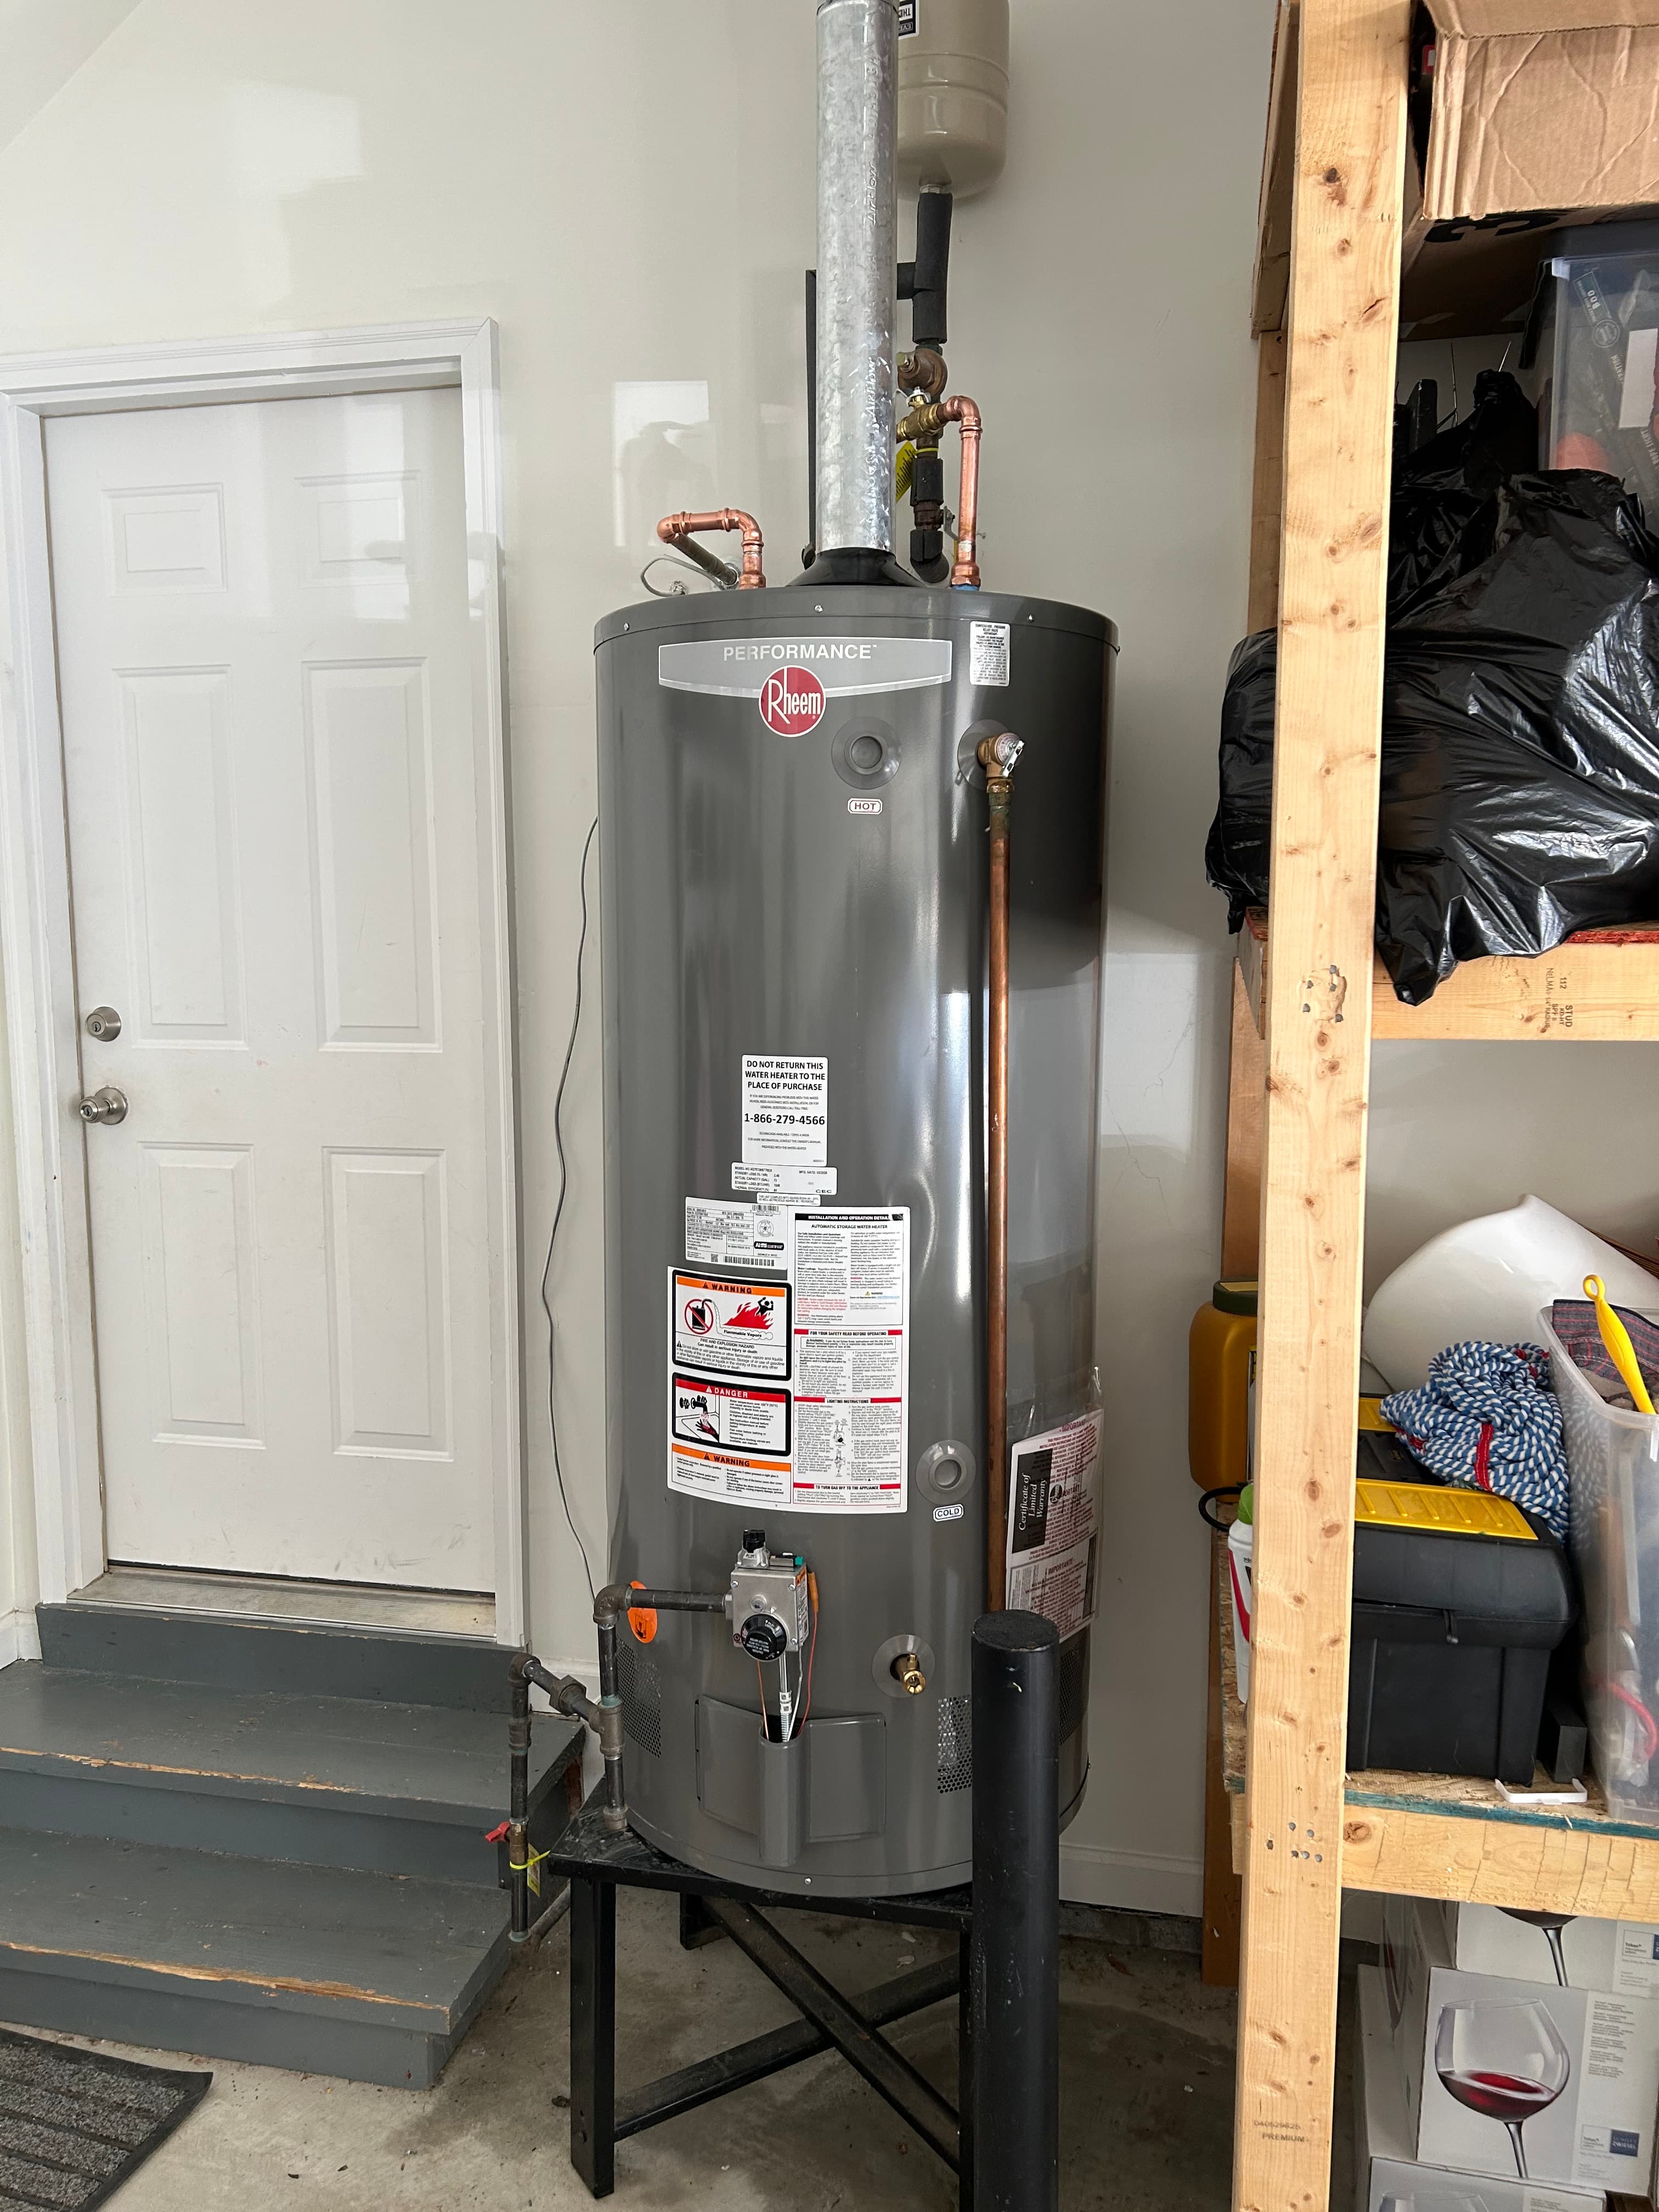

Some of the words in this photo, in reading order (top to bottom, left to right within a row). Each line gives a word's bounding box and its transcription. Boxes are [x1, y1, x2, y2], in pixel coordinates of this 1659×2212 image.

[723, 644, 871, 661] PERFORMANCE
[768, 668, 821, 724] Rheem
[744, 1113, 825, 1125] 1-866-279-4566
[712, 1283, 752, 1294] WARNING
[714, 1387, 748, 1398] DANGER
[1062, 1419, 1086, 1432] IMPORTANT
[714, 1455, 750, 1466] WARNING
[1023, 1473, 1031, 1483] of
[1029, 1484, 1037, 1517] Limited
[1037, 1480, 1047, 1517] Warranty
[937, 1507, 960, 1517] COLD
[1019, 1486, 1029, 1530] Certificate
[1262, 2133, 1305, 2142] PREMIUM
